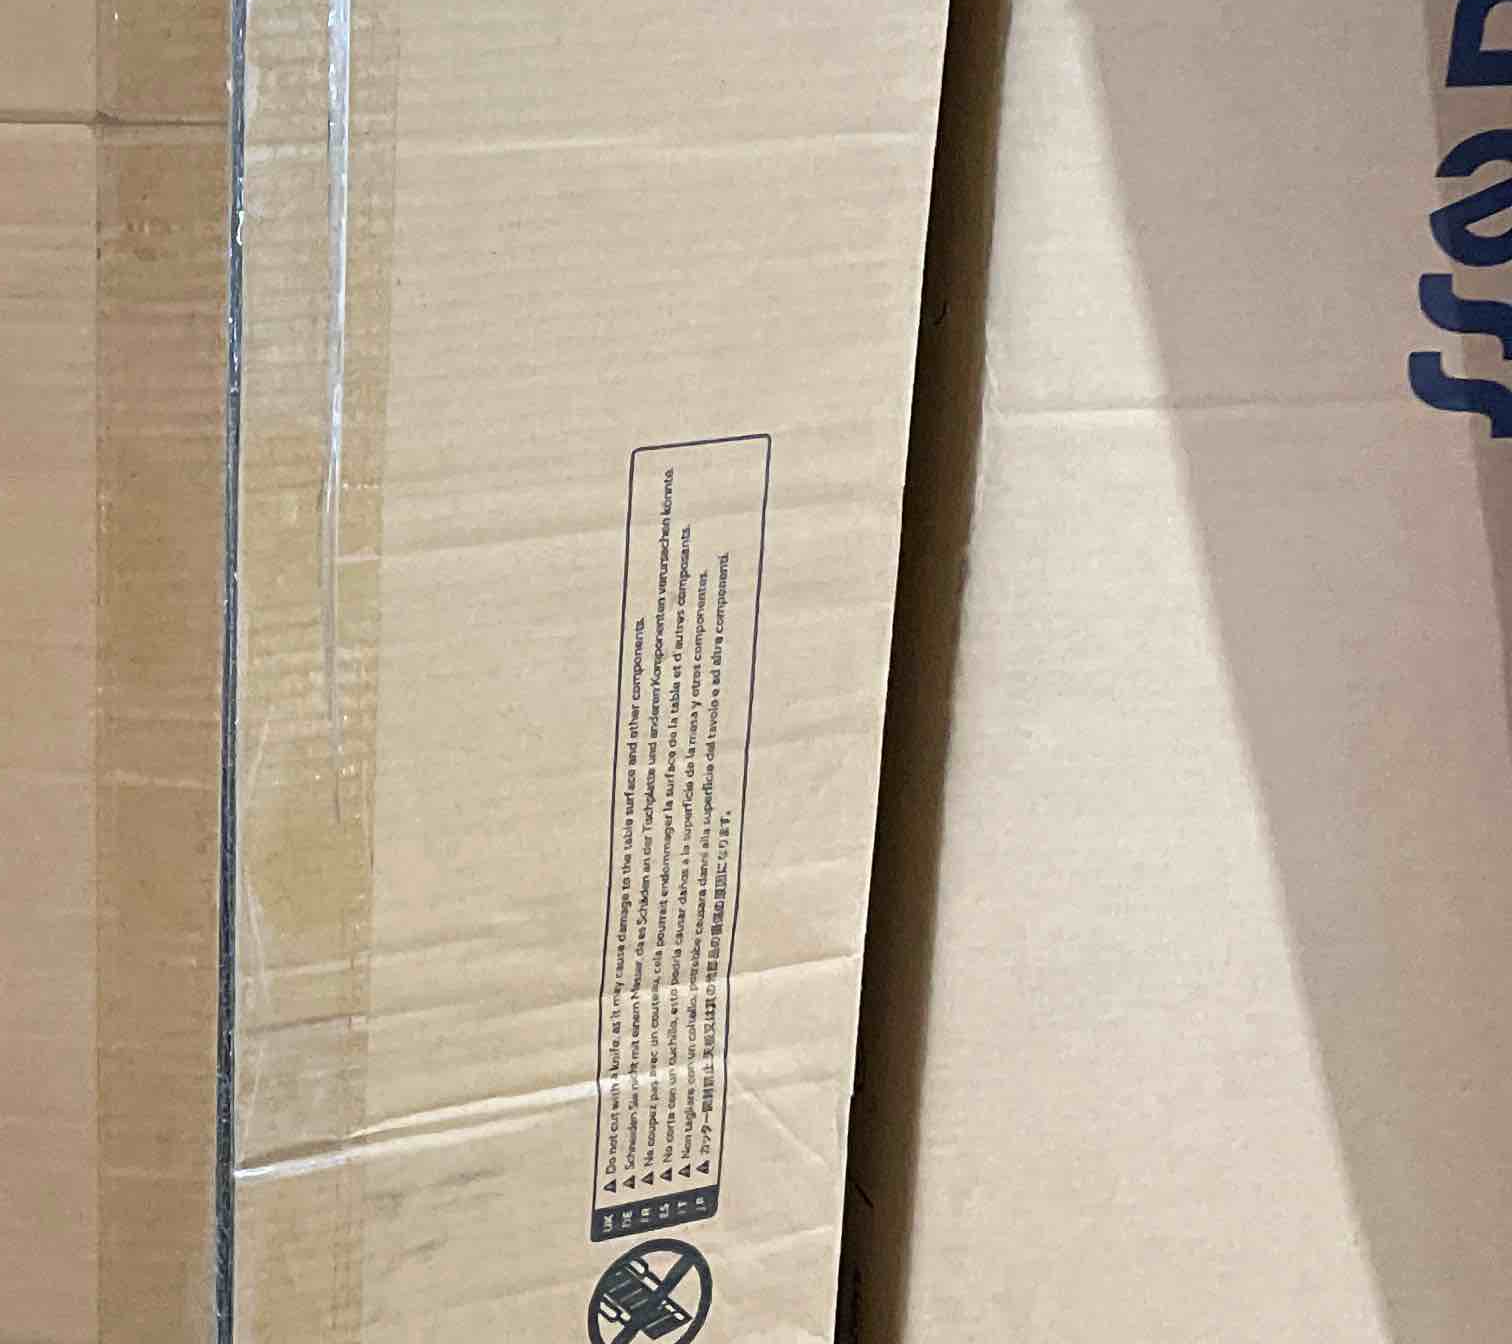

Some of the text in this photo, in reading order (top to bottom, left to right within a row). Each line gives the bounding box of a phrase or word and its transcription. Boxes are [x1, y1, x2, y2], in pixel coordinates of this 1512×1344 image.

[627, 704, 640, 738] other
[626, 741, 638, 765] and
[647, 741, 657, 765] und
[623, 768, 636, 815] surface
[623, 818, 634, 849] table
[620, 853, 632, 873] the
[616, 893, 632, 941] damage
[608, 1134, 618, 1154] not
